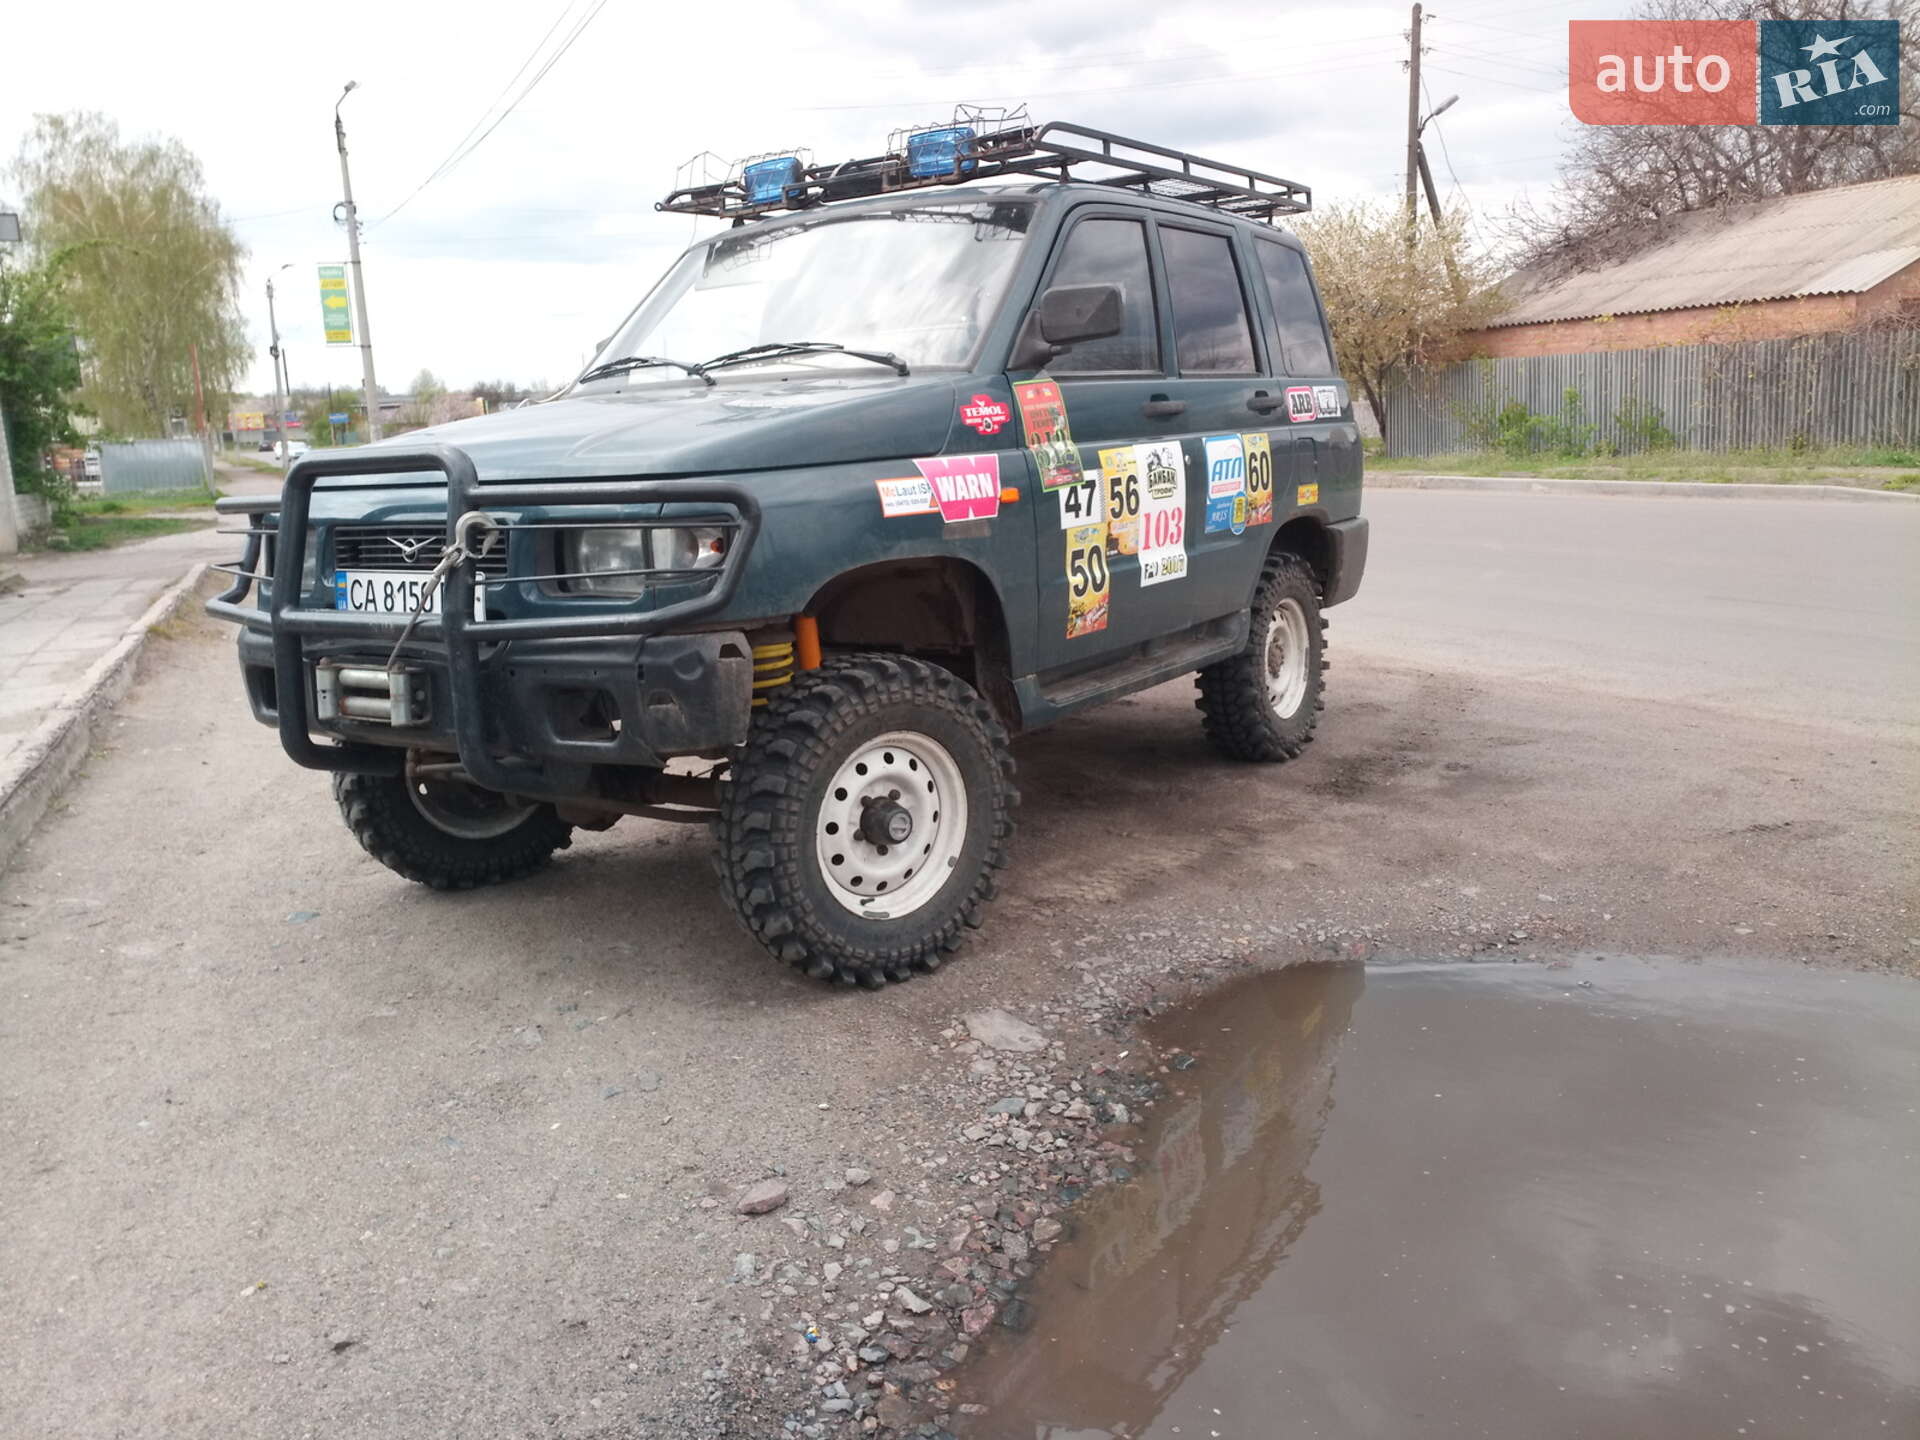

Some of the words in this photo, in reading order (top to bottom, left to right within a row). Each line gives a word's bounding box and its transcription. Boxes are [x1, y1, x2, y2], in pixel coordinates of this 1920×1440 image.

[964, 406, 1005, 417] TEMOL
[1290, 393, 1313, 414] ARB
[935, 473, 995, 502] WARN
[1249, 450, 1270, 492] 60
[1065, 479, 1096, 518] 47
[1110, 474, 1140, 519] 56
[1142, 507, 1183, 550] 103
[1070, 545, 1106, 597] 50
[350, 579, 377, 612] CA
